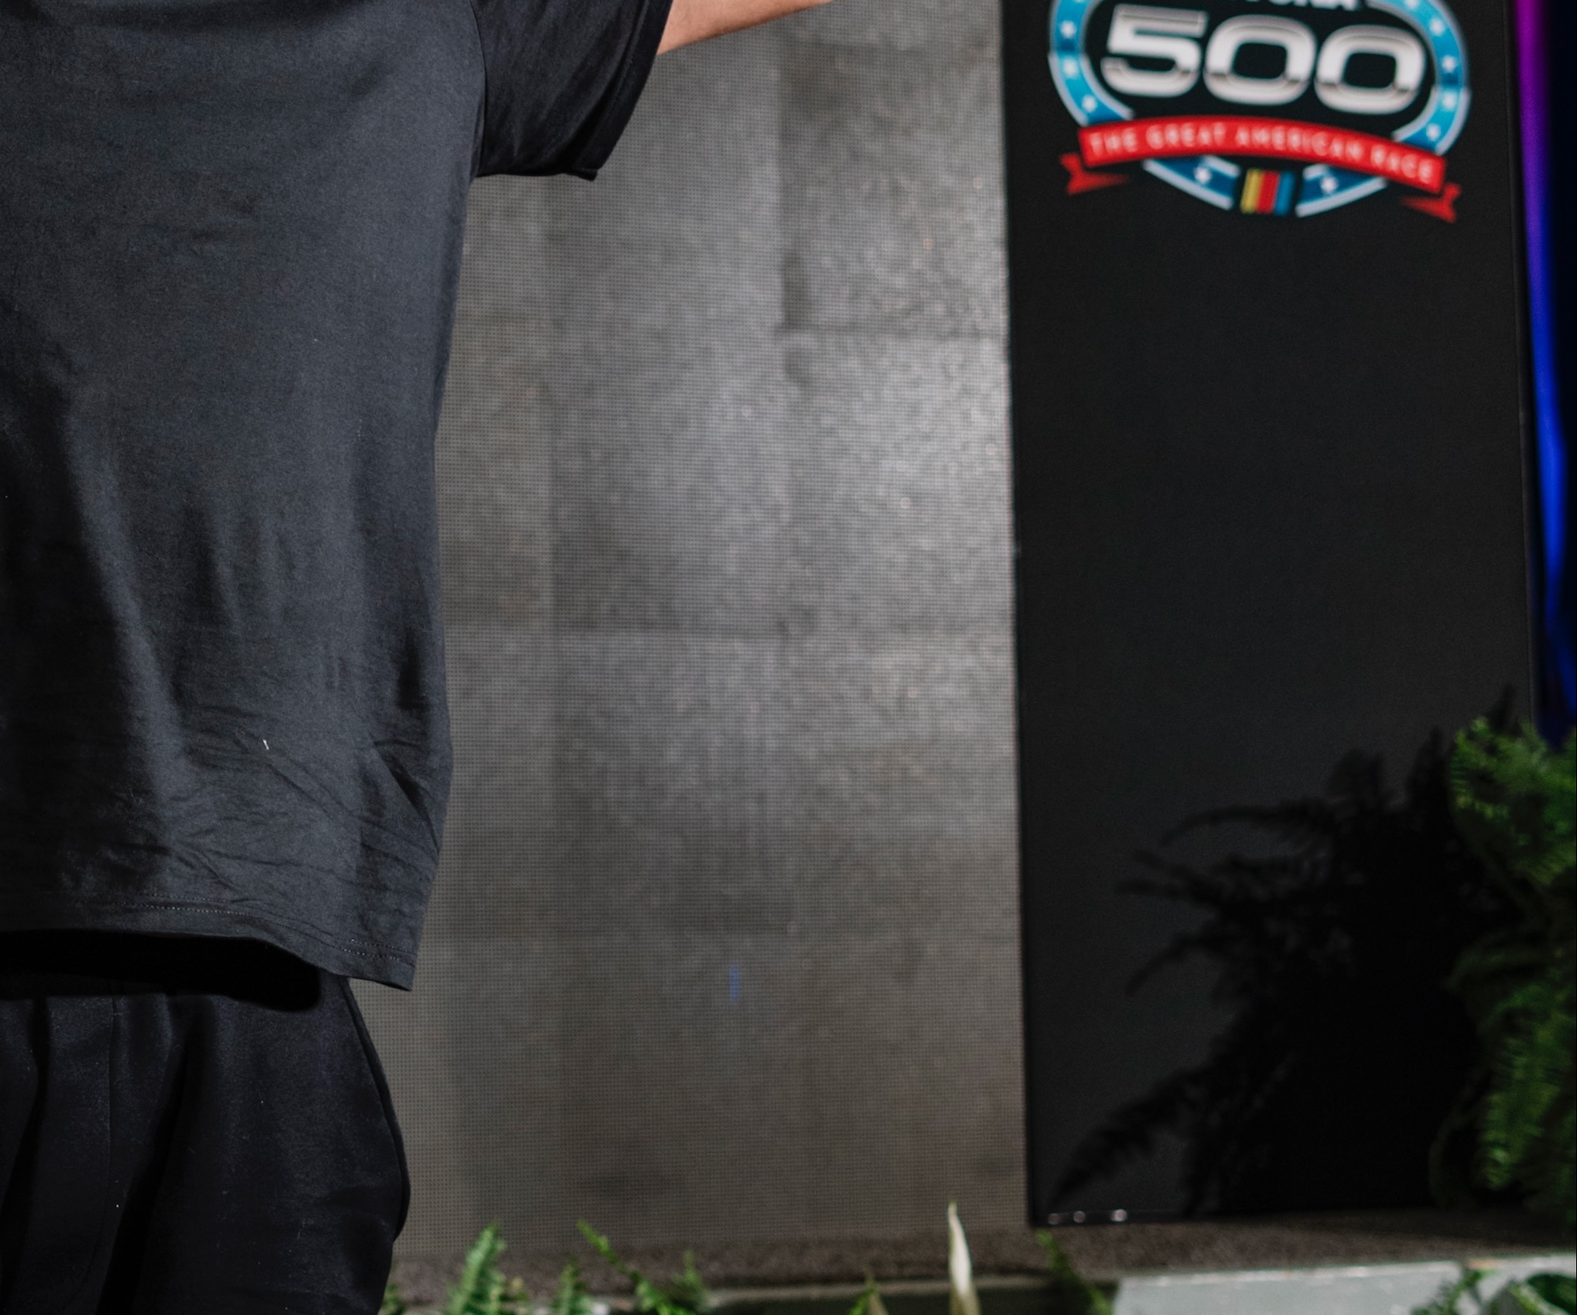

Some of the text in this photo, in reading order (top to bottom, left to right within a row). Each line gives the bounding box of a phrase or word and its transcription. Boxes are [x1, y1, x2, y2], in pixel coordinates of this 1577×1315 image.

[1100, 4, 1426, 115] 500
[1089, 121, 1433, 185] THE GREAT AMERICAN RACE
